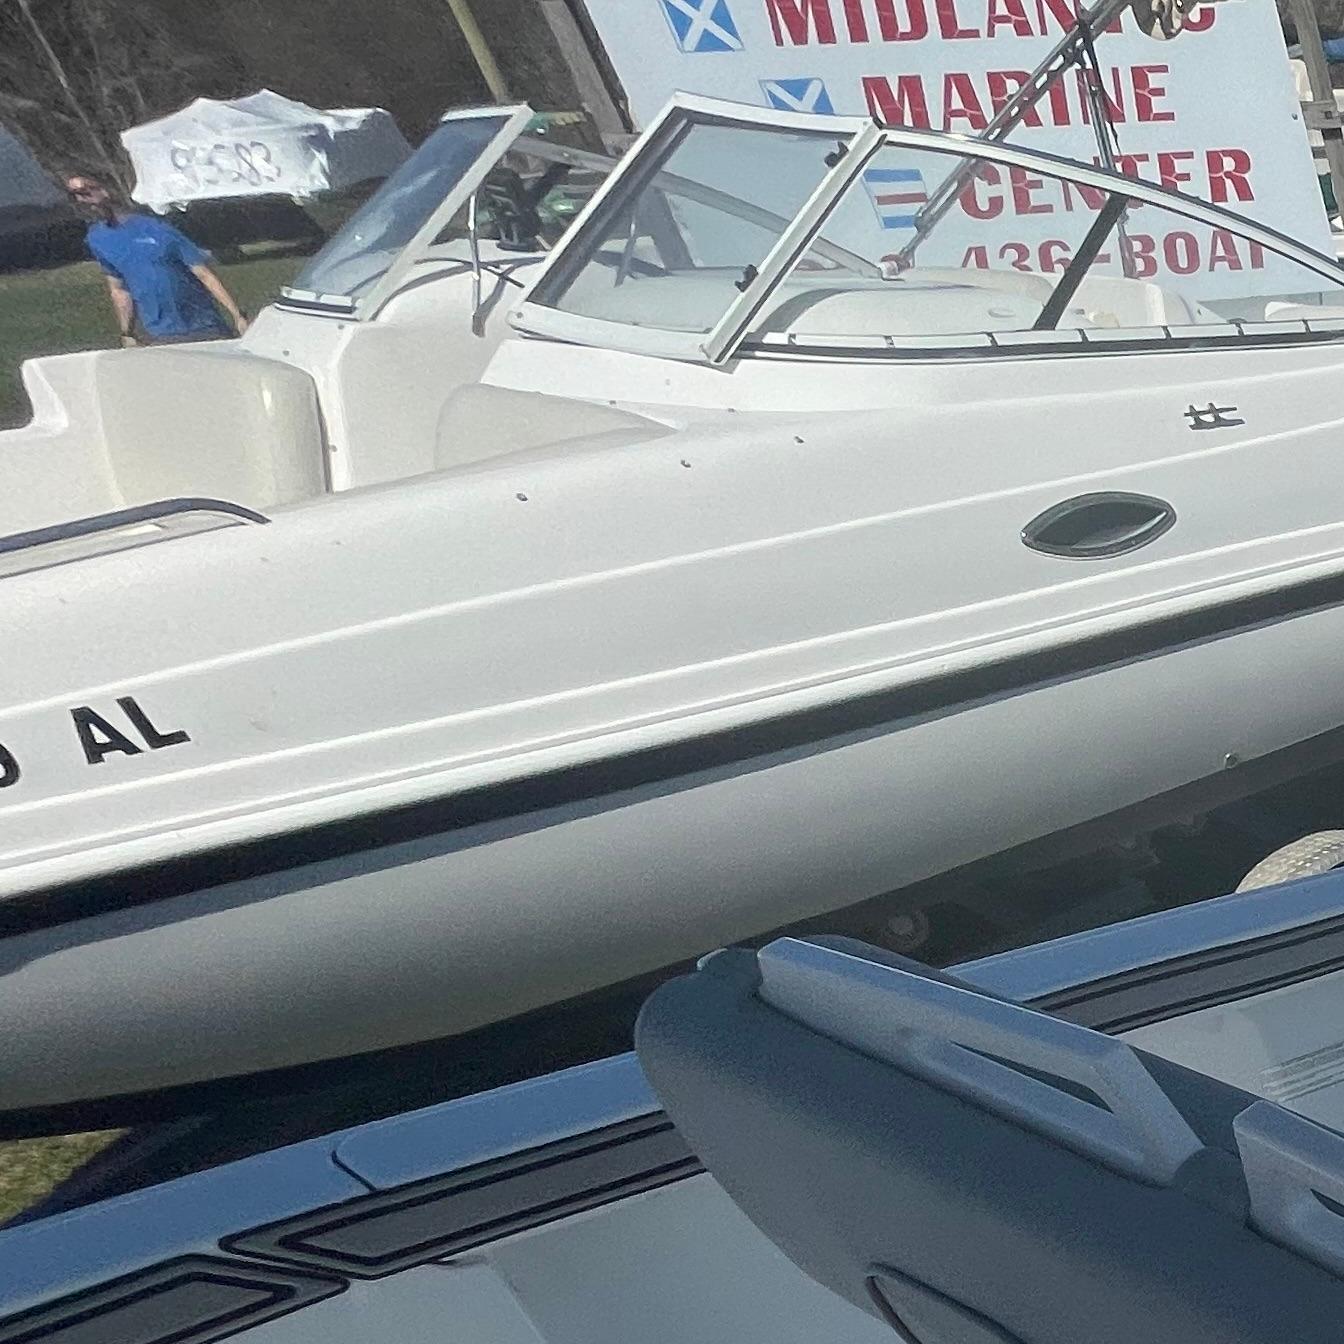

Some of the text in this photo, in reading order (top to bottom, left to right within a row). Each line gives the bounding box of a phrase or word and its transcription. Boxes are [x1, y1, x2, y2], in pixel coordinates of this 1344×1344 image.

[764, 0, 1216, 47] MIDLAN
[861, 63, 1175, 132] MARINE
[959, 148, 1256, 220] CENTER
[70, 696, 191, 765] AL
